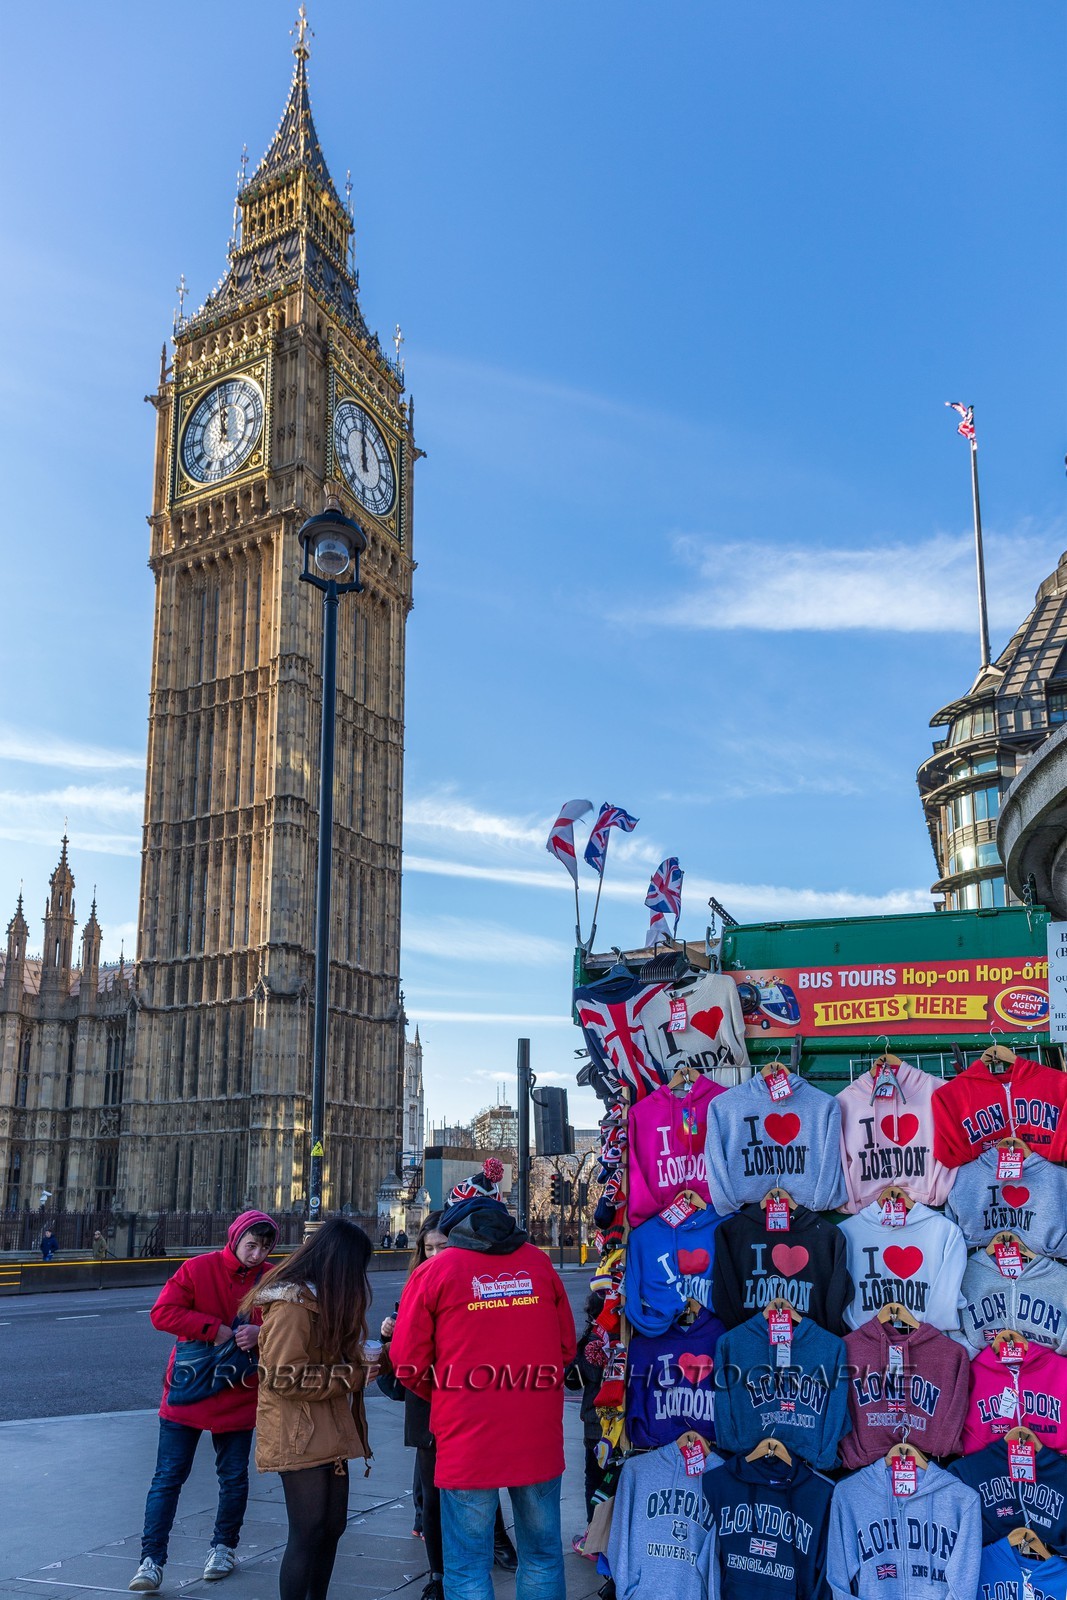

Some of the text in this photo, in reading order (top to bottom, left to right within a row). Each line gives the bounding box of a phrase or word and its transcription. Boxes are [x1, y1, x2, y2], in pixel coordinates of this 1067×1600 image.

[799, 962, 1048, 988] BUS TOURS Hop-on Hop-off
[822, 997, 967, 1022] TICKETS HERE
[1010, 993, 1048, 1003] OFFICIAL
[1012, 1002, 1042, 1010] AGENT
[657, 1126, 672, 1156] I
[744, 1116, 763, 1146] I
[858, 1117, 880, 1149] I
[656, 1153, 709, 1188] LONDO
[742, 1146, 806, 1176] LONDON
[858, 1146, 927, 1181] LONDON
[987, 1185, 1000, 1207] I
[983, 1207, 1034, 1231] LONDON
[657, 1252, 678, 1284] I
[751, 1244, 767, 1276] I
[862, 1246, 882, 1279] I
[494, 1281, 517, 1292] Original
[518, 1280, 530, 1288] Tour
[744, 1278, 813, 1312] LONDON
[859, 1278, 928, 1312] LONDON
[468, 1296, 539, 1311] OFFICIAL AGENT
[658, 1354, 674, 1386] I
[654, 1387, 715, 1421] LONDON
[746, 1372, 828, 1415] LONDON
[760, 1413, 815, 1428] ENGLAND
[866, 1412, 926, 1431] ENGLAND
[719, 1502, 813, 1554] LONDON
[727, 1554, 795, 1580] ENGLAND
[912, 1565, 948, 1582] ENGAN
